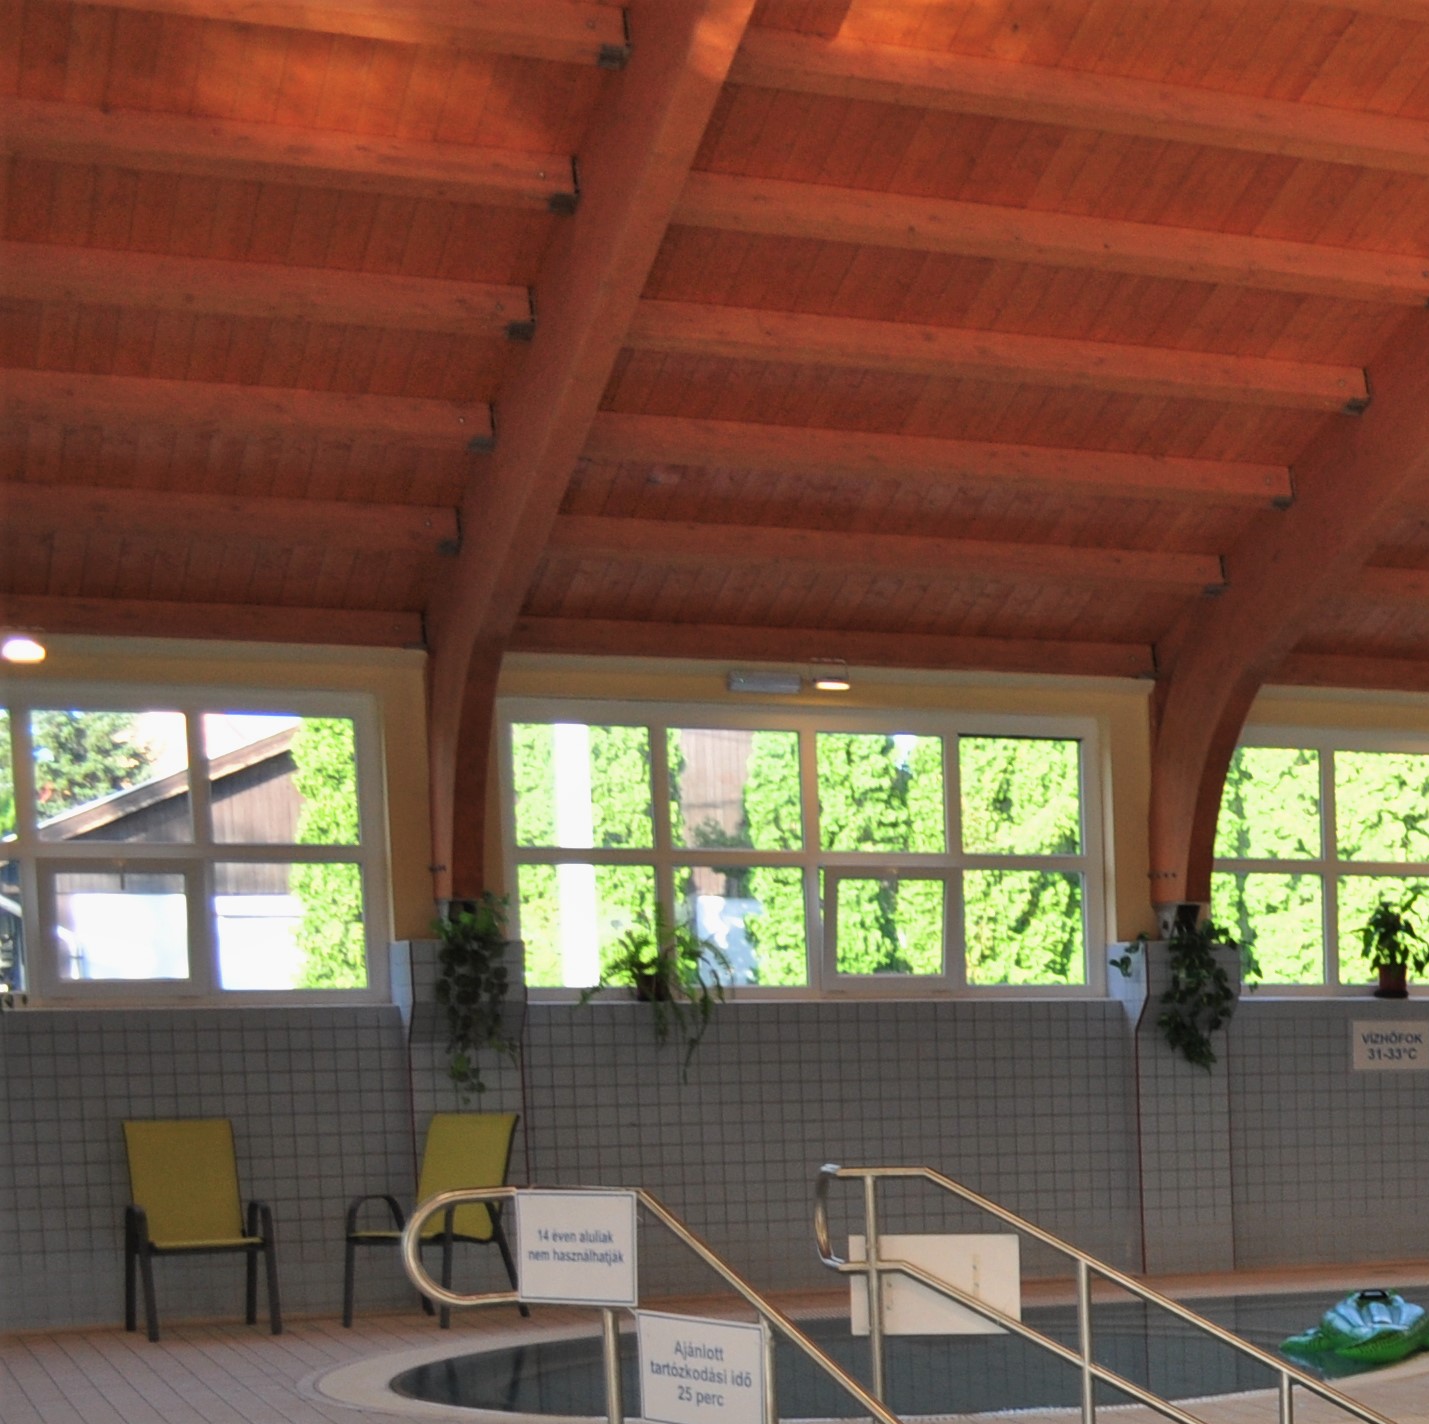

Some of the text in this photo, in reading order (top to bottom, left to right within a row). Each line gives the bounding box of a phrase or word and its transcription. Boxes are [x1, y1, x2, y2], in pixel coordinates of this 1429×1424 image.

[1361, 1030, 1424, 1044] VÍZHŐFOK
[1367, 1047, 1418, 1060] 31-33°C
[537, 1229, 614, 1244] 14 éven aluliak
[528, 1249, 624, 1267] nem használhatják
[674, 1339, 724, 1362] Ajánlott
[650, 1360, 753, 1388] tartózkodási idő
[677, 1385, 725, 1407] 25 perc
